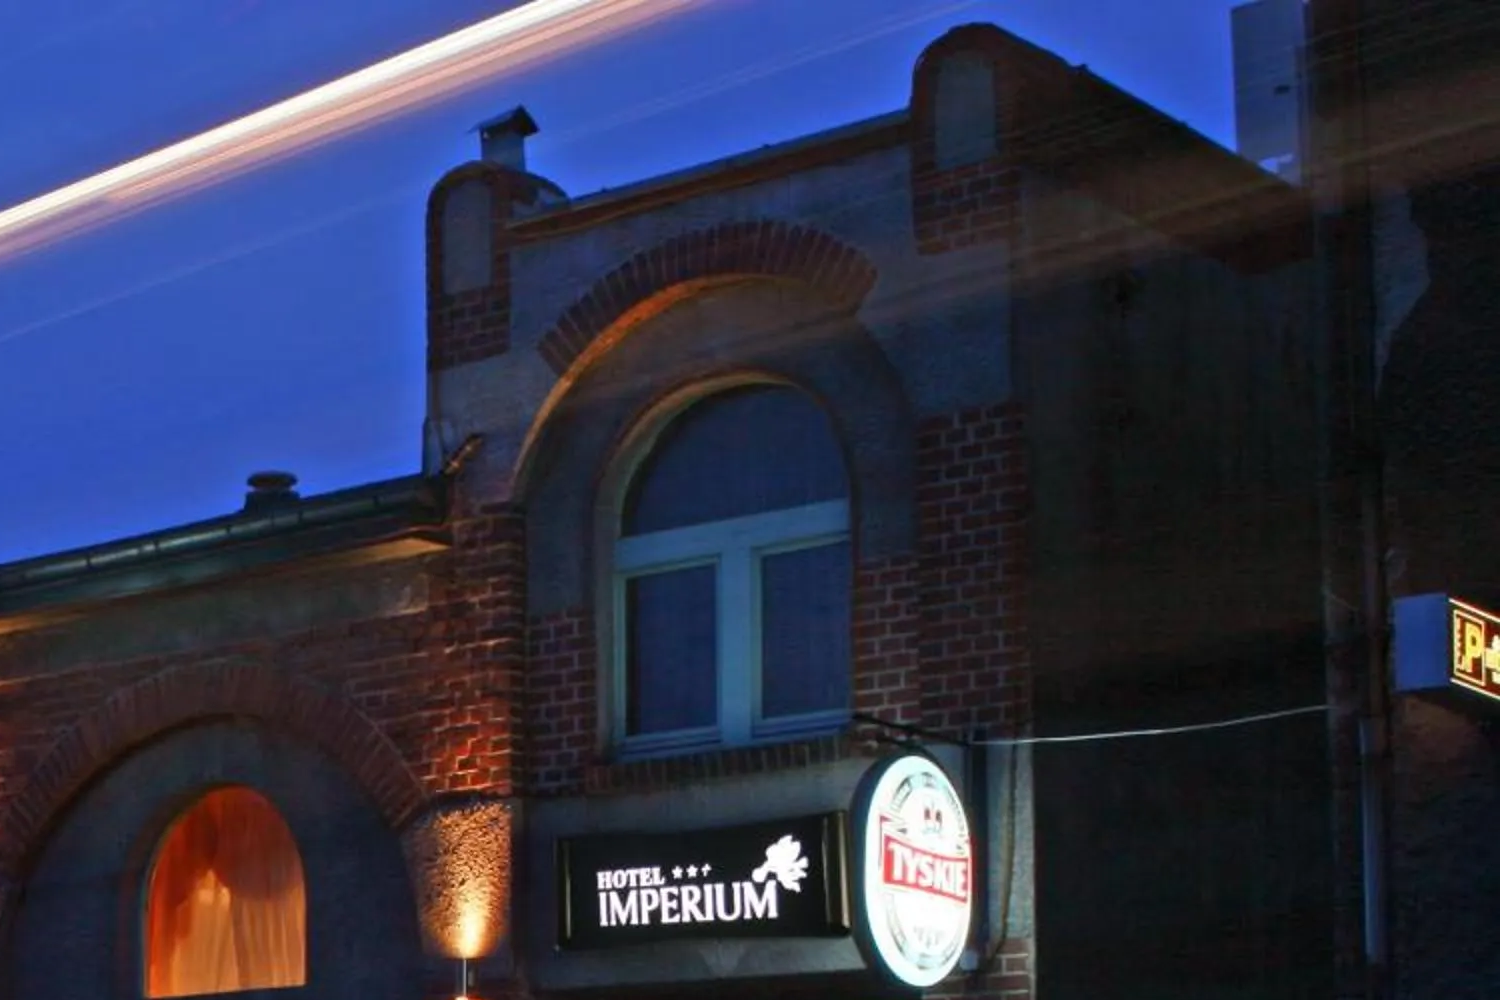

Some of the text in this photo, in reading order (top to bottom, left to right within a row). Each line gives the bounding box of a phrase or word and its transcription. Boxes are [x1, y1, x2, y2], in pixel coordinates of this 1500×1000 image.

[596, 866, 666, 890] HOTEL
[888, 841, 967, 898] TYSKIE
[598, 880, 779, 927] IMPERIUM
